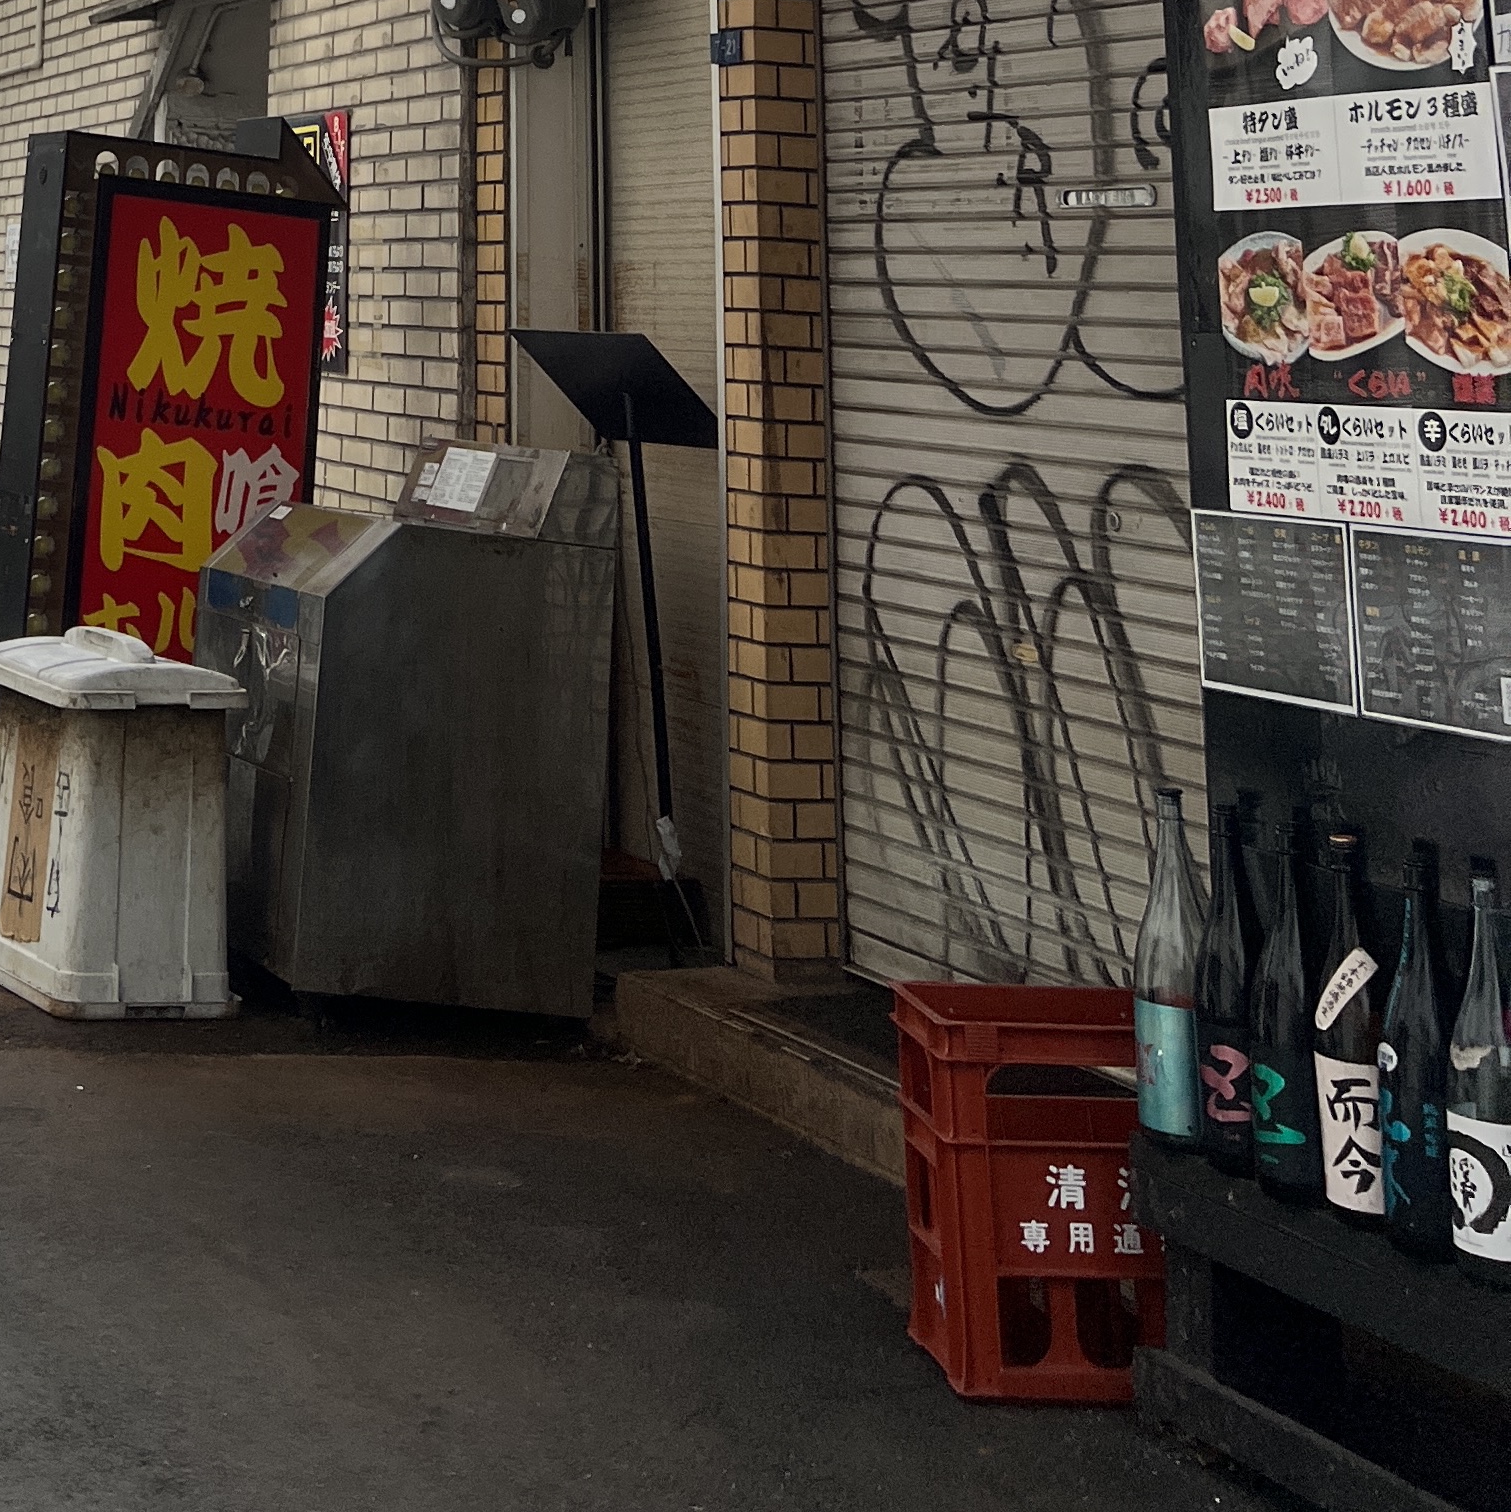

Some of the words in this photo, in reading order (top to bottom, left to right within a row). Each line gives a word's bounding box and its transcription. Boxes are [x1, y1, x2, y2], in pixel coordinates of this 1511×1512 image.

[1325, 1077, 1381, 1201] 而今
[1019, 1219, 1165, 1255] 専用通
